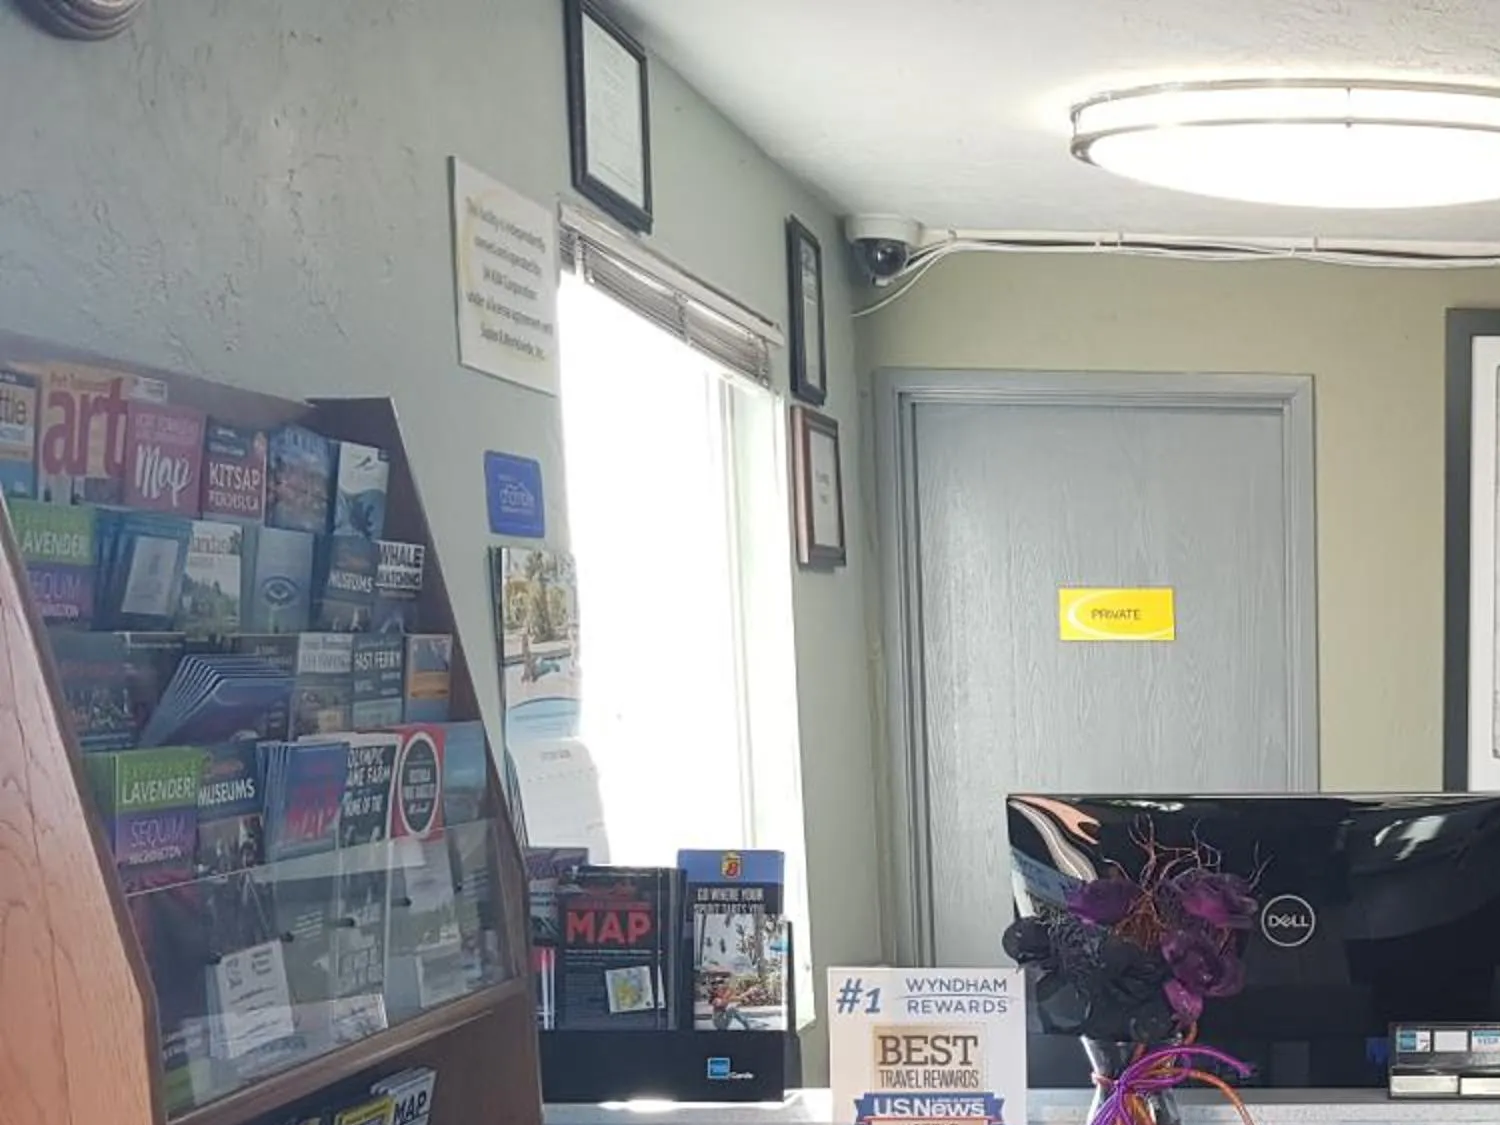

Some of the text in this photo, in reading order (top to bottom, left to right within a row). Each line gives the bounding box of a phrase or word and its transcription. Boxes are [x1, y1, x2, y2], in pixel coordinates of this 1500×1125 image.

[209, 461, 261, 491] KITSAP
[1091, 608, 1142, 621] PRIVATE
[198, 777, 257, 806] MUSEUMS
[566, 912, 652, 944] MAP
[1268, 914, 1310, 928] DELL
[836, 978, 881, 1015] #1
[905, 978, 1008, 993] WYNDHAM
[907, 999, 1008, 1014] REWARDS
[877, 1035, 979, 1067] BEST
[879, 1069, 979, 1089] TRAVEL REWARDS
